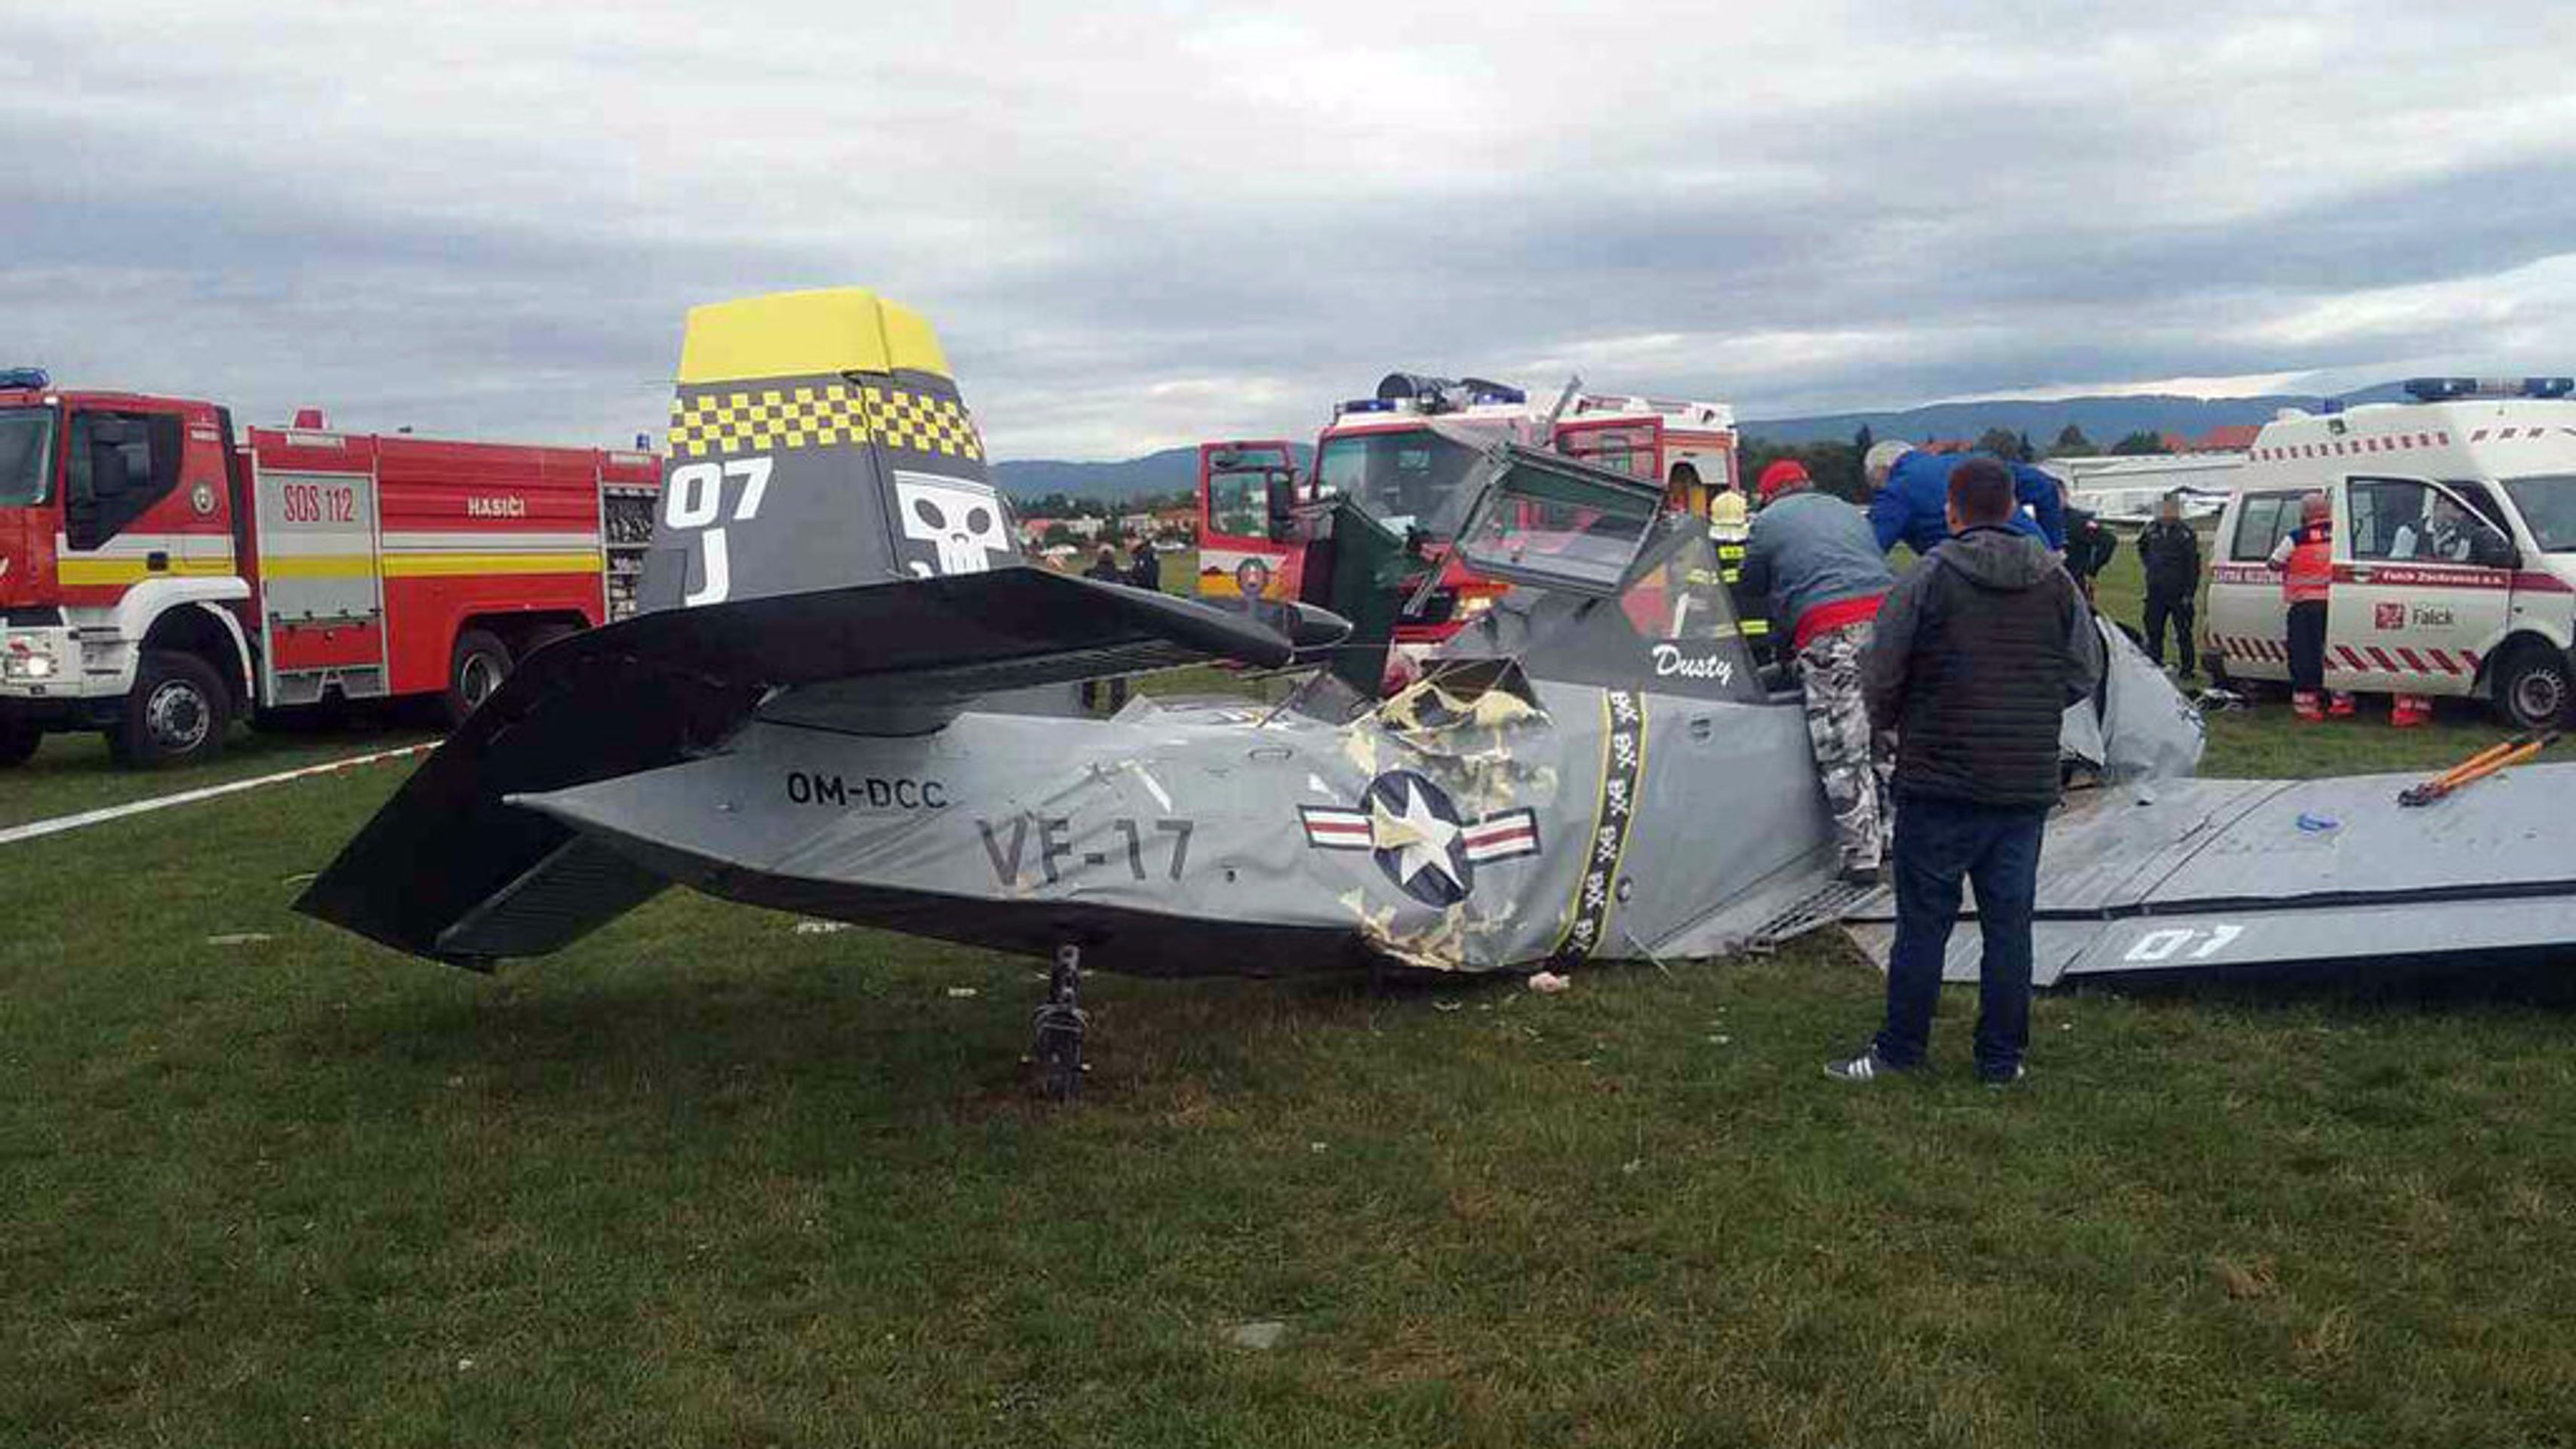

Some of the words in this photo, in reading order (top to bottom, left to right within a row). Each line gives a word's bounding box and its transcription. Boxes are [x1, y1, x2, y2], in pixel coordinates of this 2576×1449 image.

[284, 485, 321, 522] SOS
[325, 487, 355, 522] 112
[666, 457, 774, 529] 07
[685, 528, 730, 608] J
[2412, 608, 2453, 626] Falck
[1652, 645, 1734, 687] Dusty
[787, 771, 947, 809] OM-DCC
[977, 815, 1194, 886] VF-17
